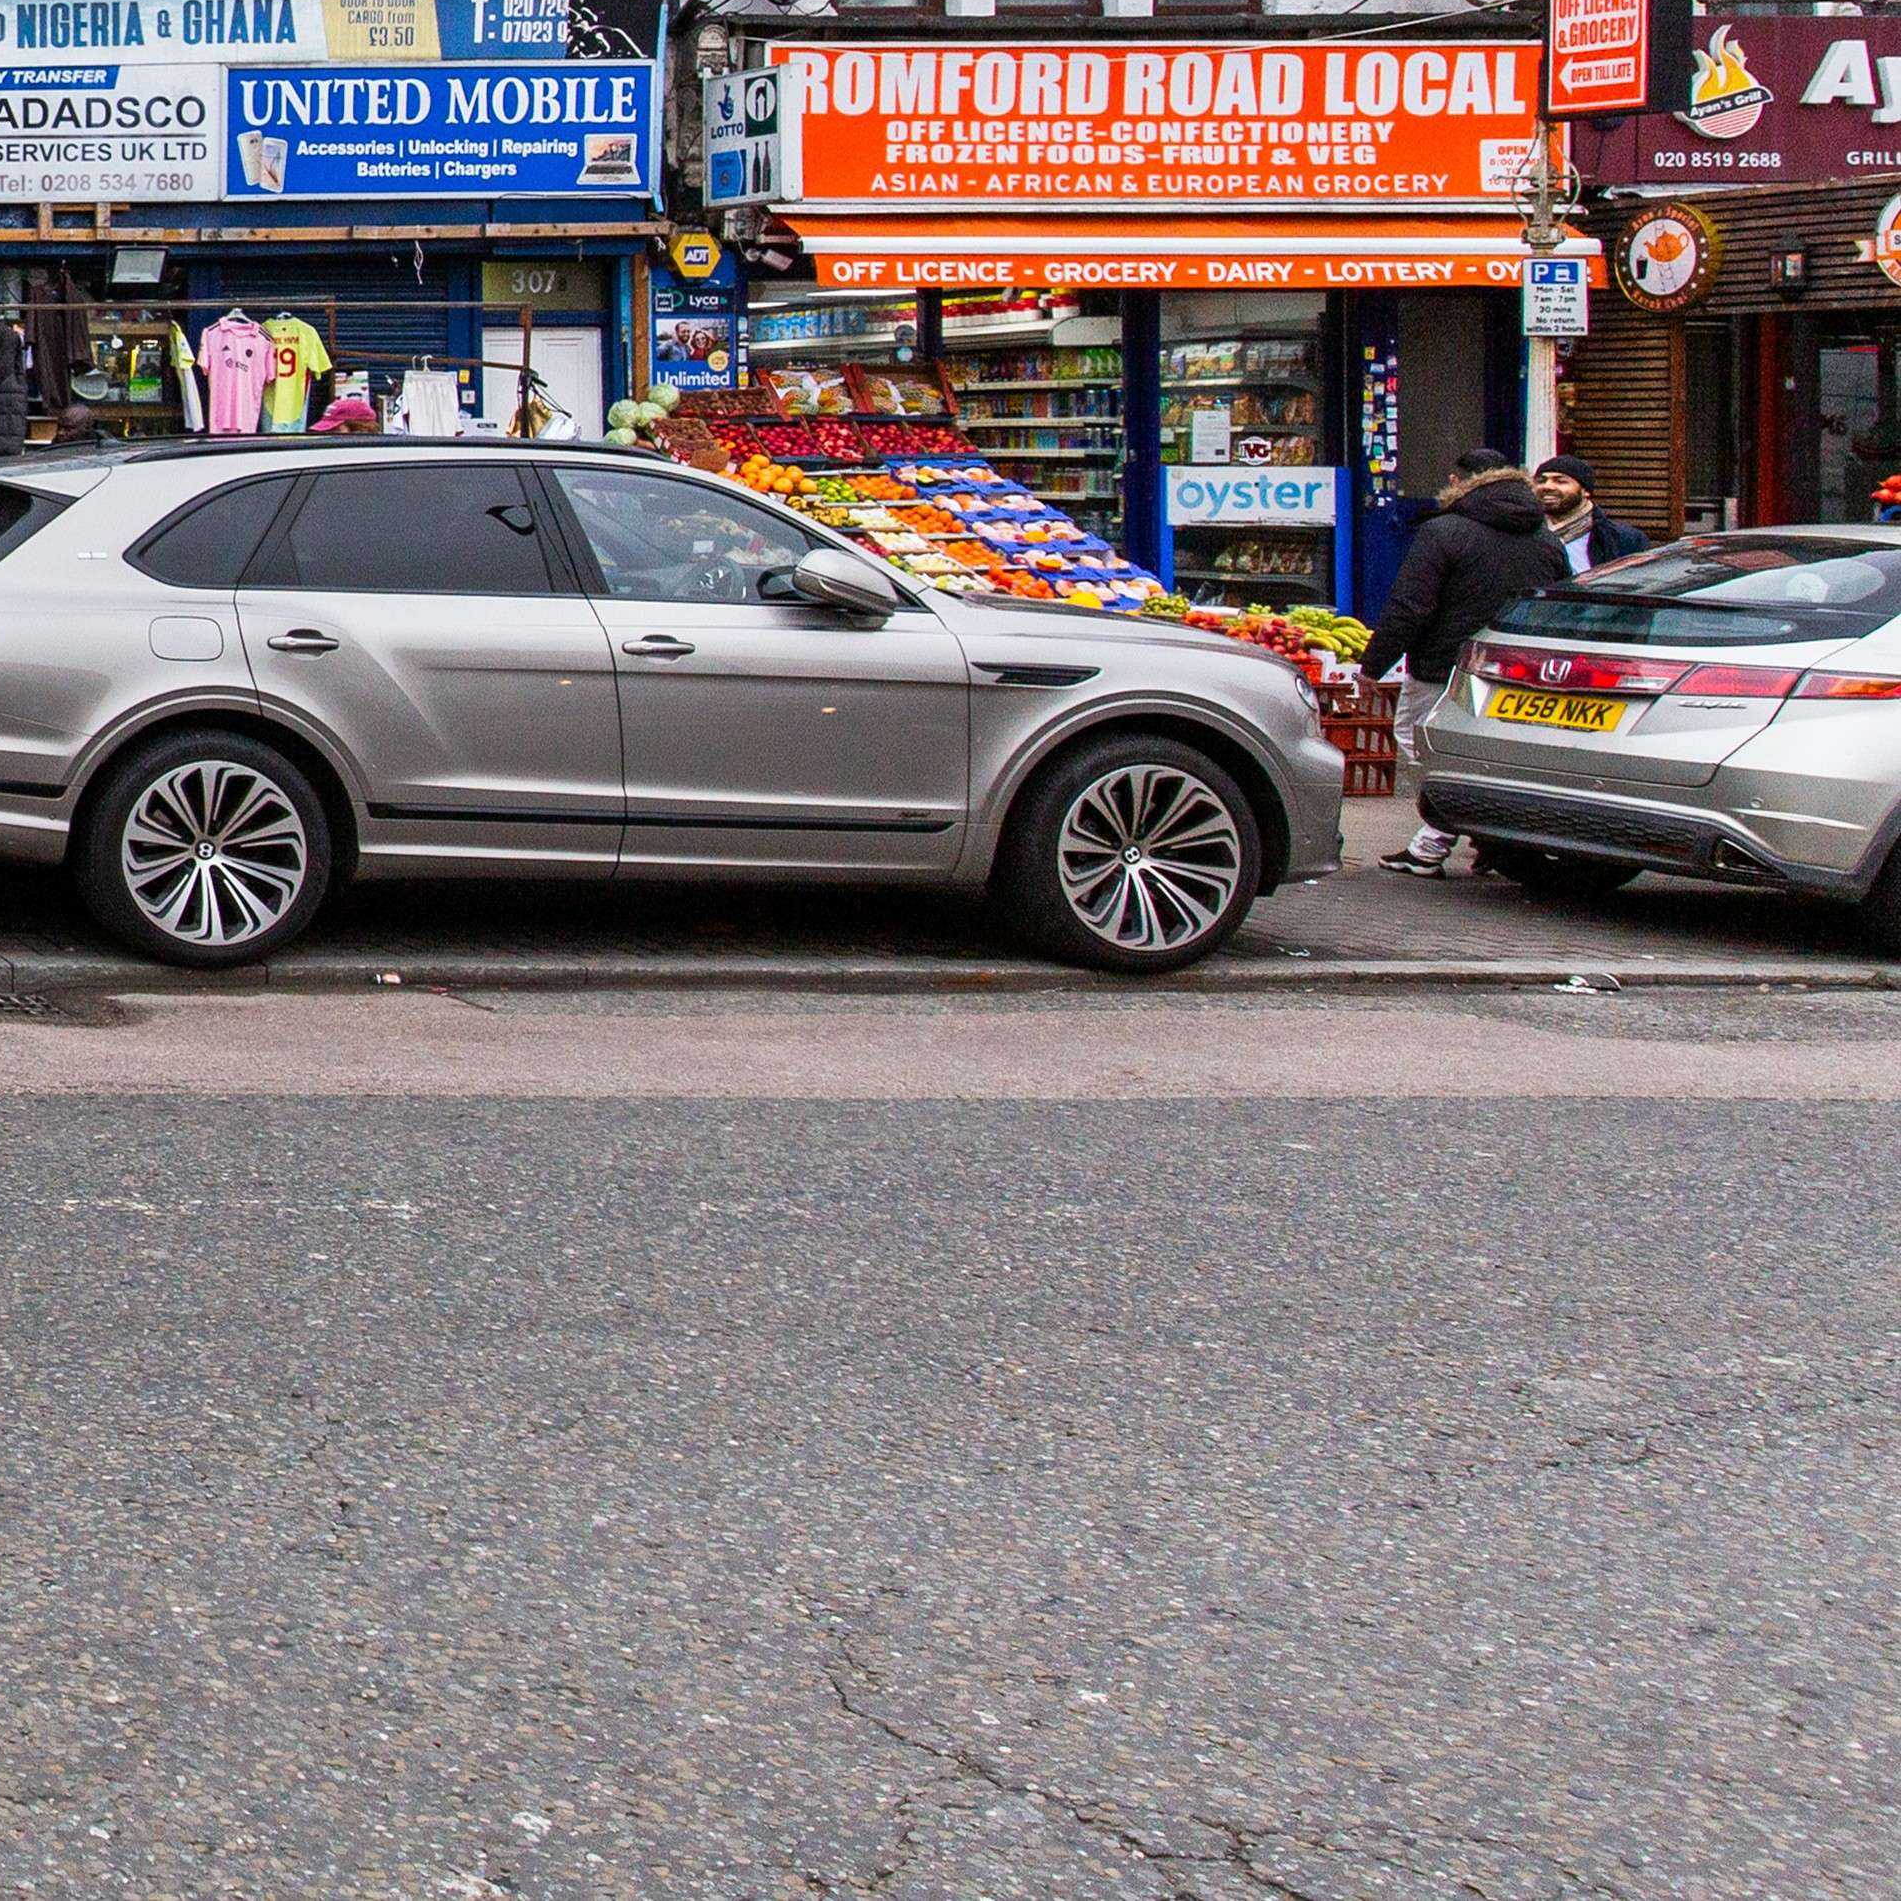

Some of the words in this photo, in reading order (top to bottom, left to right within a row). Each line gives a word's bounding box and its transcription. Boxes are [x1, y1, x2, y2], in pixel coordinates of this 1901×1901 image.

[17, 1, 145, 48] NIGERIA
[158, 9, 172, 38] &
[182, 0, 297, 45] GHANA
[348, 10, 384, 24] CARGO
[369, 26, 415, 47] £3.50
[502, 21, 553, 43] 07923
[1558, 29, 1568, 48] &
[1569, 15, 1637, 47] GROCERY
[12, 69, 108, 85] TRANSFER
[788, 51, 1109, 116] ROMFORD
[1124, 51, 1305, 117] ROAD
[1324, 51, 1526, 117] LOCAL
[239, 77, 432, 127] UNITED
[445, 76, 638, 125] MOBILE
[1690, 99, 1732, 118] Ayan's
[1734, 90, 1763, 107] Grill
[711, 122, 744, 139] LOTTO
[886, 121, 944, 143] OFF
[121, 142, 155, 161] UK
[163, 141, 208, 161] LTD
[296, 139, 396, 157] Accessories
[407, 139, 490, 158] Unlocking
[501, 138, 579, 157] Repairing
[886, 144, 1019, 164] FROZEN
[1271, 147, 1297, 165] &
[1308, 146, 1378, 165] VEG
[356, 161, 432, 178] Batteries
[443, 160, 518, 179] Chargers
[1654, 151, 1686, 168] 020
[1690, 151, 1734, 168] 8519
[1737, 151, 1782, 169] 2688
[41, 173, 92, 192] 0208
[99, 172, 137, 192] 534
[146, 172, 194, 192] 7680
[871, 174, 959, 193] ASIAN
[985, 173, 1114, 193] AFRICAN
[1121, 174, 1139, 193] &
[1147, 174, 1305, 194] EUROPEAN
[1313, 174, 1450, 194] GROCERY
[684, 249, 709, 263] ADT
[511, 270, 557, 294] 307
[833, 261, 887, 282] OFF
[896, 261, 1015, 282] LICENCE
[1044, 261, 1178, 283] GROCERY
[1207, 261, 1294, 283] DAIRY
[1325, 261, 1455, 283] LOTTERY
[1534, 264, 1549, 282] P
[689, 294, 719, 307] Lyca
[1536, 316, 1547, 324] No
[1550, 316, 1576, 324] return
[1554, 325, 1559, 333] 2
[1562, 325, 1585, 333] hours
[656, 370, 730, 386] Unlimited
[1176, 474, 1324, 518] oyster
[1497, 694, 1555, 719] CV58
[1559, 699, 1613, 726] NKK
